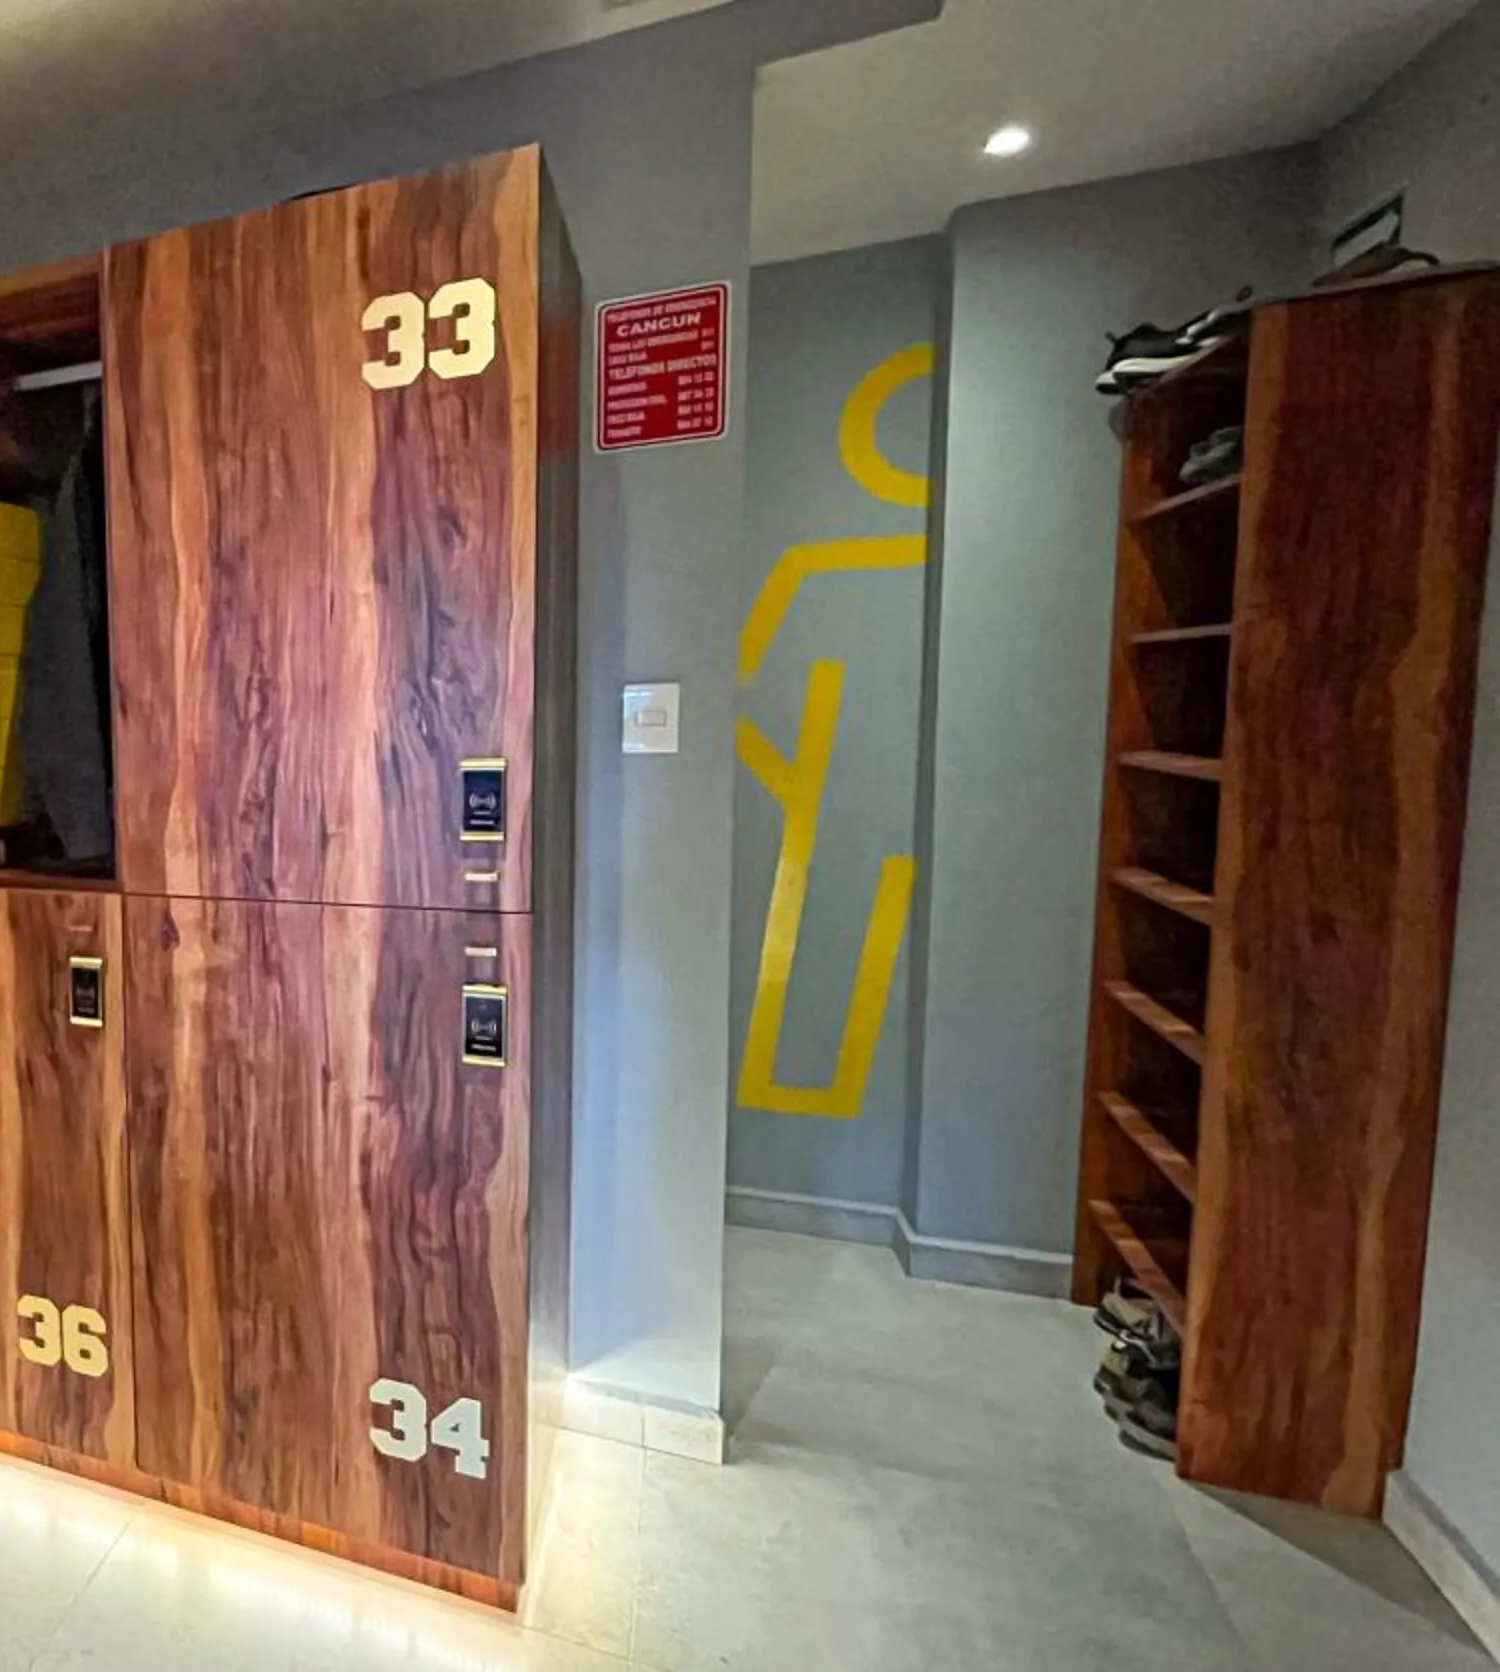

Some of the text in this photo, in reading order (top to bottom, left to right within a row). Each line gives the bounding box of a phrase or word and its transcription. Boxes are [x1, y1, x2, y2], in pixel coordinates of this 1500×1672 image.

[361, 277, 496, 391] 33
[616, 312, 701, 337] CANCUN
[17, 1294, 108, 1377] 36
[369, 1378, 490, 1480] 34
